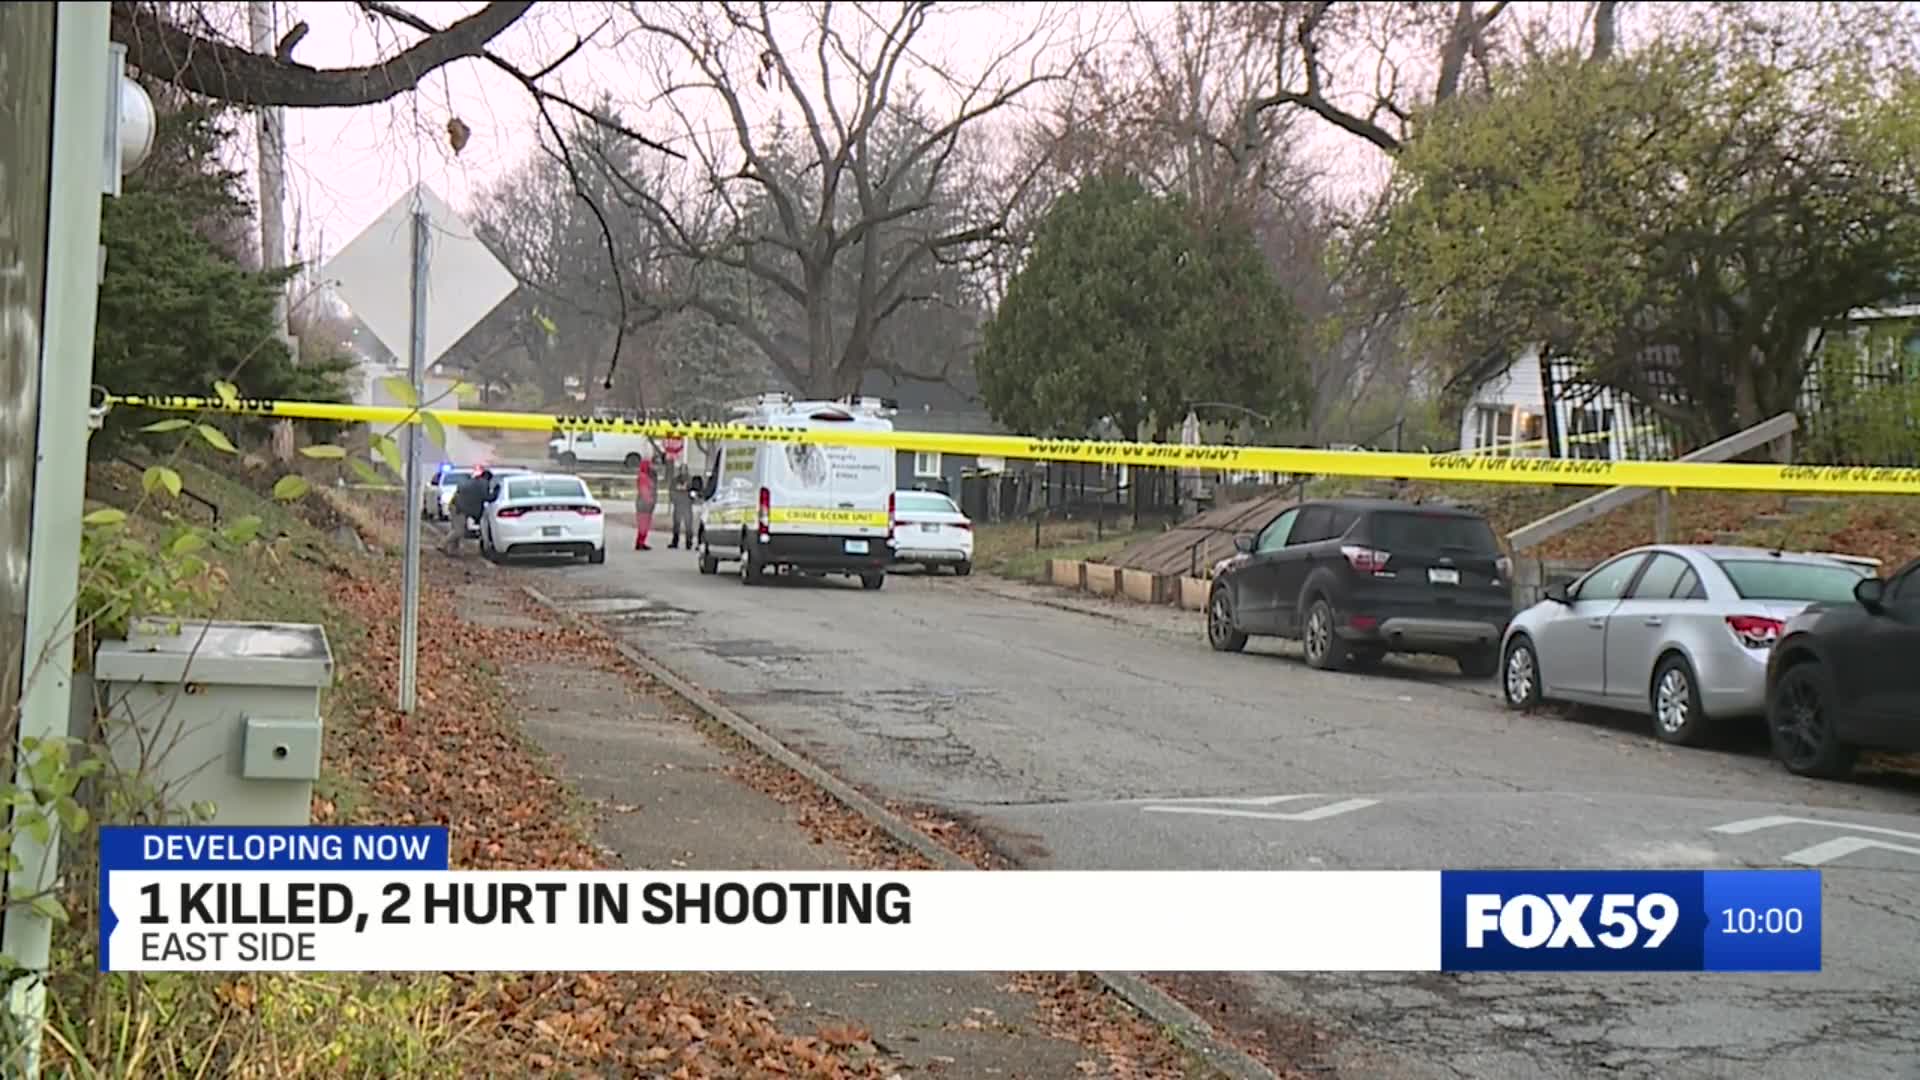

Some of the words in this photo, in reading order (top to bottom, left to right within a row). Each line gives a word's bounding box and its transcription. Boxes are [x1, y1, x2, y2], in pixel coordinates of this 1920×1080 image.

[786, 511, 817, 520] CRIME
[820, 512, 850, 521] SCENE
[852, 513, 873, 521] UNIT
